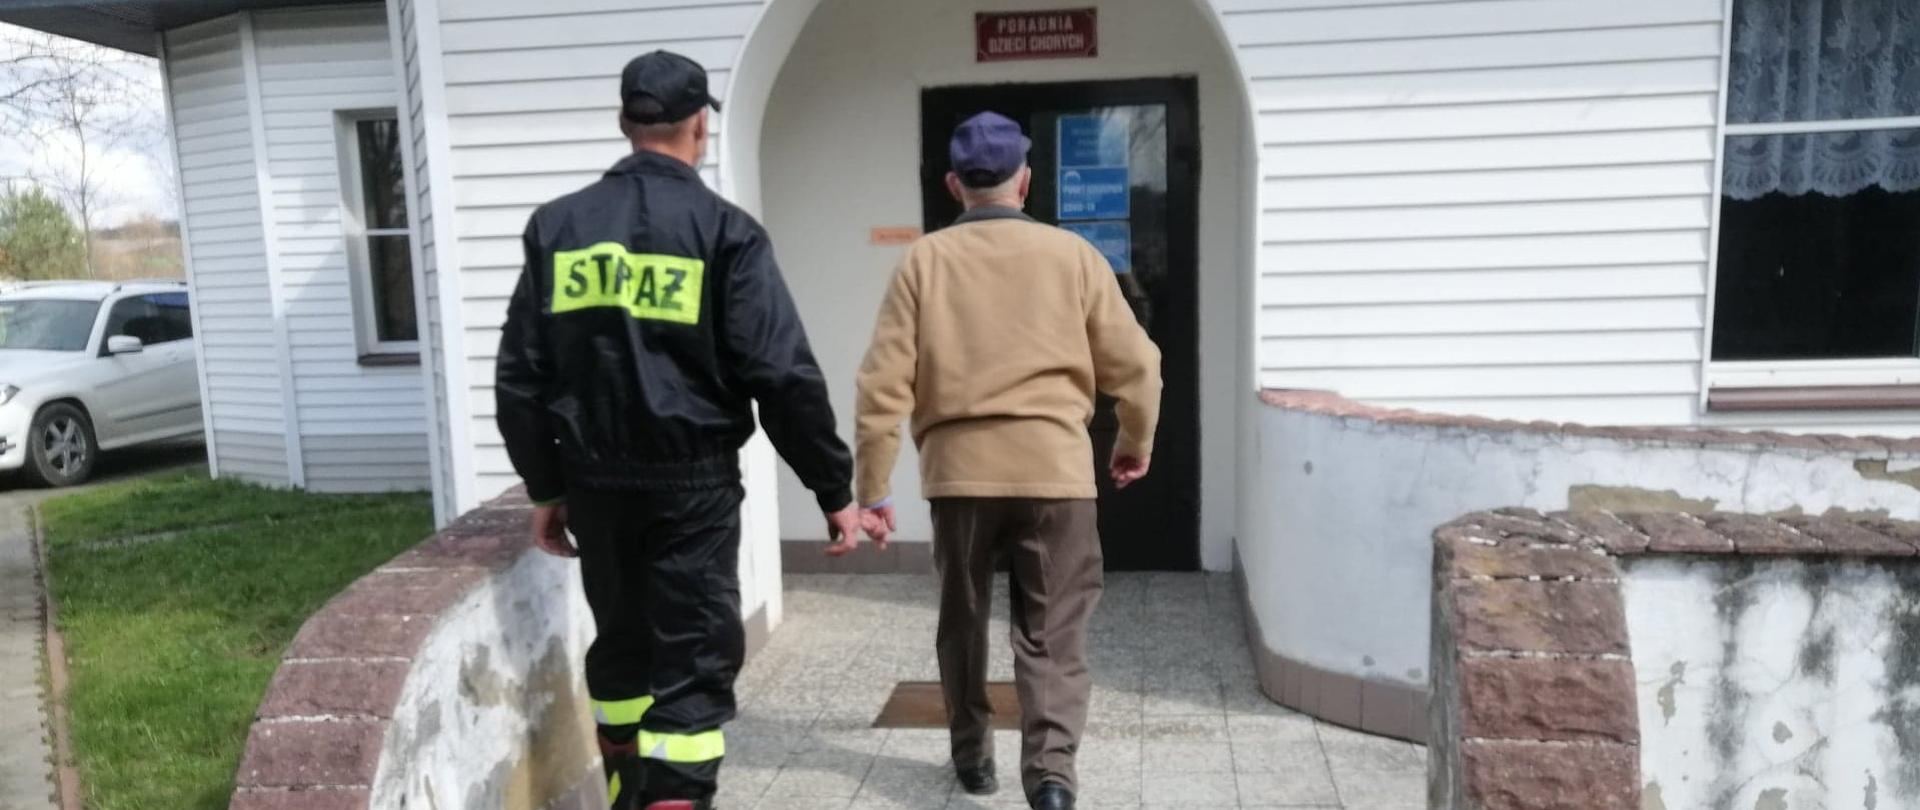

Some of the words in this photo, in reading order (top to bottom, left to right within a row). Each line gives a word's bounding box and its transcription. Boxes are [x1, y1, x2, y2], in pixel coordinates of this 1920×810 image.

[998, 15, 1073, 33] PORADNIA
[988, 36, 1026, 53] DZIECI
[1029, 32, 1084, 51] CHORYCH
[564, 253, 687, 311] STRAŻ
